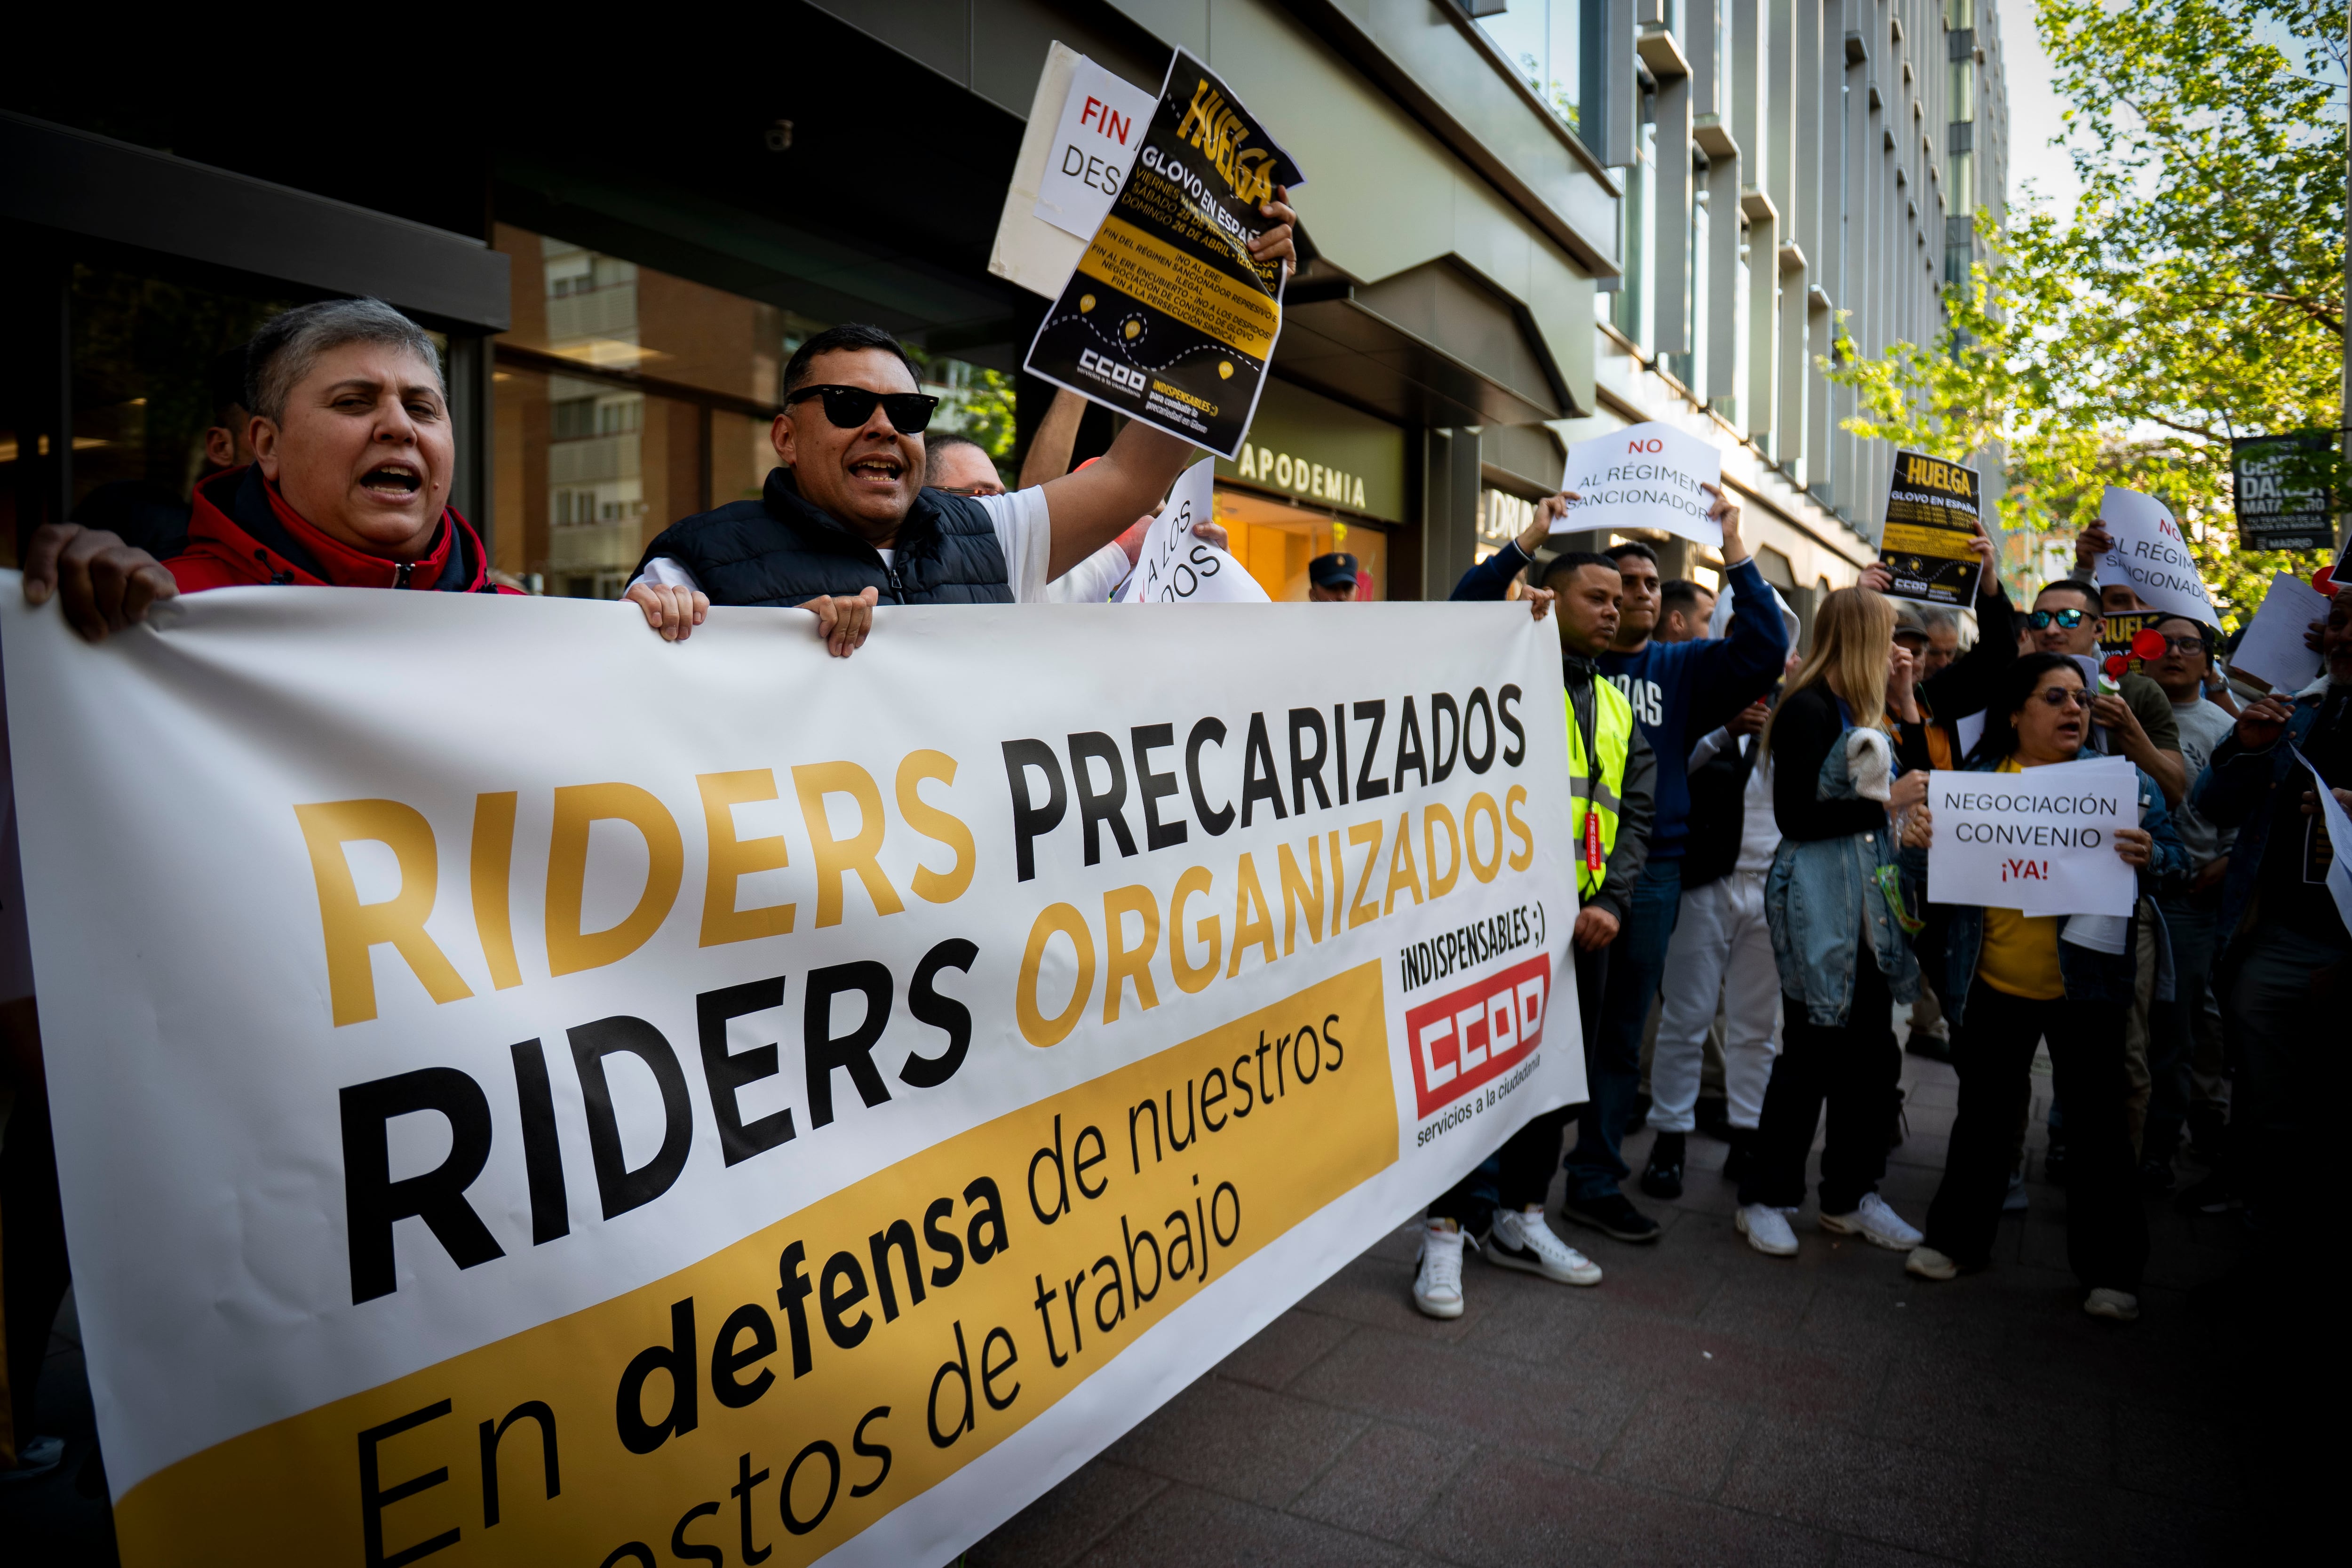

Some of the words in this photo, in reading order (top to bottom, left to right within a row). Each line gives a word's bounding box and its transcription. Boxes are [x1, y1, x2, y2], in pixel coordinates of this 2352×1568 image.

[1081, 95, 1131, 145] FIN
[1176, 78, 1277, 212] HUELGA
[1062, 143, 1121, 196] DES
[1136, 166, 1180, 200] VIERNES
[1131, 181, 1177, 213] SÁBADO
[1142, 145, 1202, 198] GLOVO
[1200, 188, 1217, 217] EN
[1217, 205, 1261, 246] ESPAÑ
[1121, 192, 1172, 226] DOMINGO
[1172, 219, 1187, 233] 26
[1186, 227, 1202, 241] DE
[1200, 235, 1229, 257] ABRIL
[1091, 242, 1106, 256] FIN
[1106, 250, 1119, 262] AL
[1119, 257, 1136, 271] ERE
[1136, 266, 1189, 298] ENCUBIERTO
[1216, 307, 1232, 320] LOS
[1103, 227, 1118, 240] FIN
[1118, 234, 1135, 249] DEL
[1135, 242, 1172, 268] RÉGIMEN
[1172, 263, 1232, 299] SANCIONADOR
[1231, 294, 1272, 319] REPRESIVO
[1175, 275, 1204, 295] ILEGAL
[1191, 261, 1203, 273] AL
[1203, 268, 1222, 283] ERE!
[1101, 258, 1160, 294] NEGOCIACIÓN
[1160, 289, 1172, 300] DE
[1173, 295, 1214, 322] CONVENIO
[1215, 317, 1226, 327] DE
[1226, 322, 1254, 341] GLOVO
[1111, 275, 1126, 288] FIN
[1126, 282, 1134, 292] A
[1134, 287, 1146, 298] LA
[1146, 292, 1201, 326] PERSECUCIÓN
[1202, 321, 1237, 343] SINDICAL
[1628, 438, 1663, 454] NO
[1239, 442, 1366, 509] APODEMIA
[1578, 474, 1602, 491] AL
[1607, 462, 1703, 497] RÉGIMEN
[1906, 456, 1971, 498] HUELGA
[1565, 489, 1708, 522] SANCIONADOR
[1891, 490, 1929, 504] GLOVO
[1930, 495, 1944, 506] EN
[1946, 499, 1978, 516] ESPAÑA
[1148, 557, 1158, 595] A
[1163, 500, 1191, 570] LOS
[2159, 518, 2181, 542] NO
[2106, 554, 2211, 604] SANCIONADO
[2135, 541, 2199, 578] RÉGIME
[1946, 792, 2117, 816] NEGOCIACIÓN
[294, 748, 976, 1027] RIDERS
[1001, 683, 1527, 882] PRECARIZADOS
[1955, 822, 2101, 848] CONVENIO
[2002, 859, 2049, 883] ¡YA!
[340, 938, 979, 1305] RIDERS
[1015, 784, 1534, 1048] ORGANIZADOS
[1419, 974, 1544, 1093] CCOO
[1417, 1102, 1472, 1148] servicios
[1476, 1097, 1484, 1114] a
[1486, 1089, 1496, 1108] la
[1498, 1052, 1541, 1100] ciudadanía
[358, 1397, 561, 1568] En
[616, 1175, 1009, 1456] defensa
[1026, 1115, 1107, 1226] de
[1128, 1012, 1346, 1157] nuestros
[598, 1406, 892, 1568] stos
[926, 1326, 1022, 1450] de
[1037, 1179, 1240, 1368] trabajo
